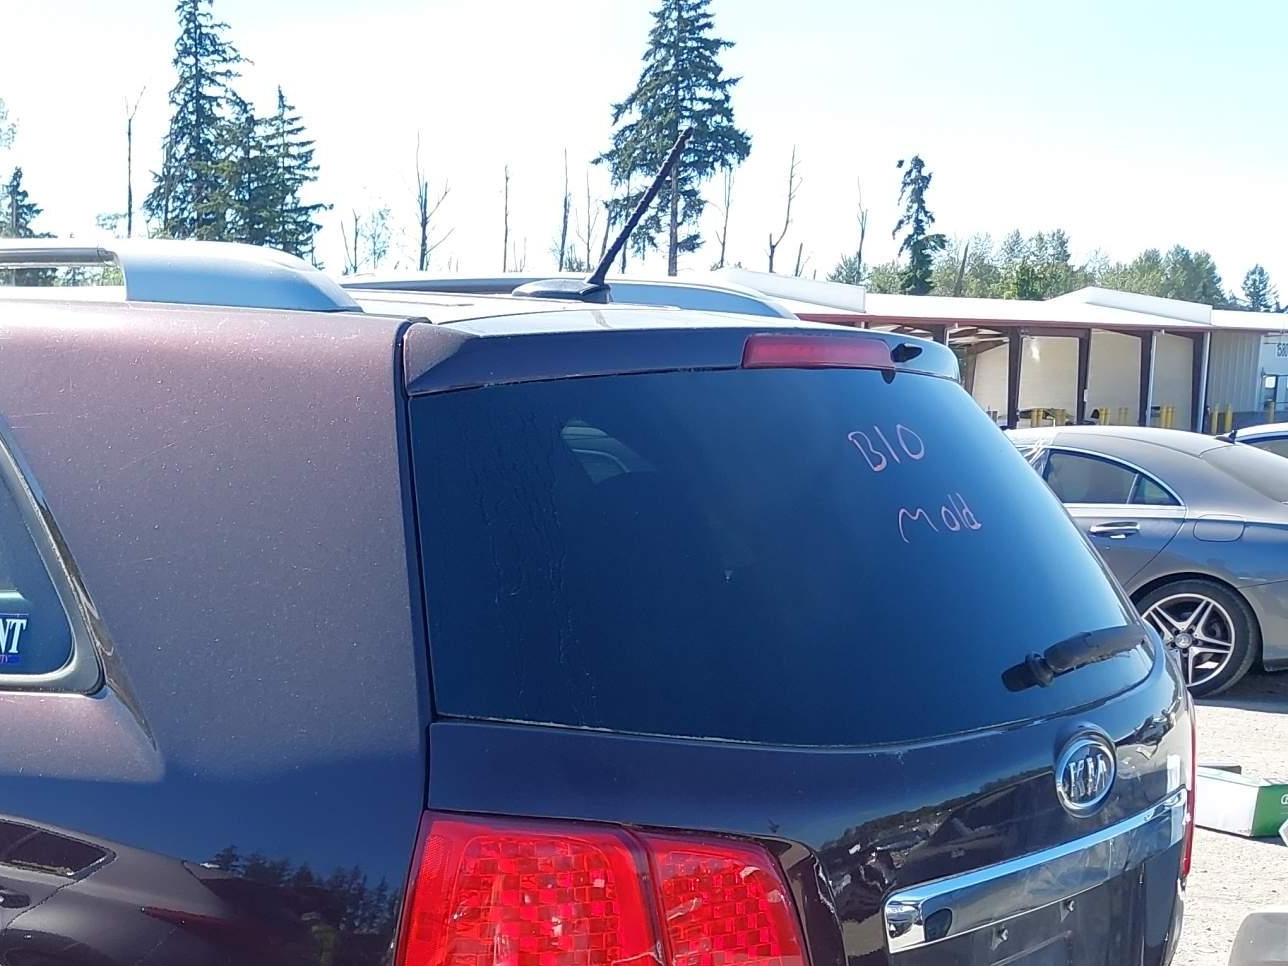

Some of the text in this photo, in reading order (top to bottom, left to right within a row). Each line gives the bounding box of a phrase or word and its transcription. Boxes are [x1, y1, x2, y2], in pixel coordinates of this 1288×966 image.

[848, 424, 925, 472] BIO
[898, 491, 982, 543] Mold
[1068, 753, 1108, 798] KIA
